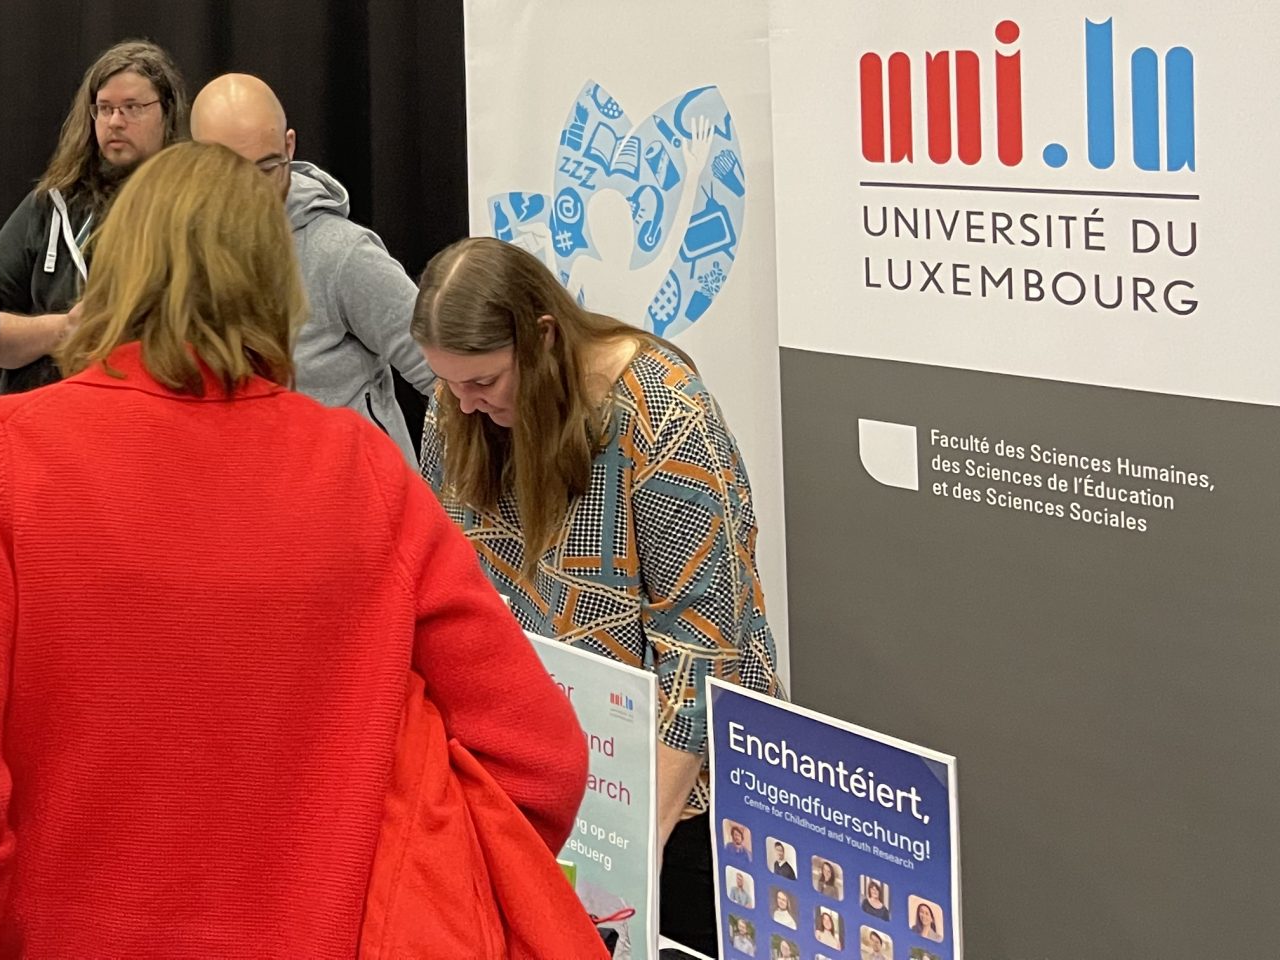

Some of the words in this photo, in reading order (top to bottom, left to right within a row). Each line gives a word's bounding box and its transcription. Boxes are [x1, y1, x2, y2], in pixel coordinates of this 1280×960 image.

[860, 16, 1196, 172] uni.lu
[863, 205, 1106, 252] UNIVERSITÉ
[1132, 219, 1197, 257] DU
[864, 257, 1199, 316] LUXEMBOURG
[930, 428, 990, 454] Faculté
[995, 439, 1025, 460] des
[1030, 444, 1112, 473] Sciences
[1117, 457, 1215, 492] Humaines,
[931, 454, 960, 474] des
[965, 459, 1043, 488] Sciences
[1047, 473, 1068, 493] de
[932, 481, 949, 497] et
[952, 482, 982, 503] des
[986, 488, 1065, 518] Sciences
[1070, 502, 1147, 532] Sociales
[582, 730, 615, 757] nd
[729, 721, 930, 825] Enchantéiert,
[566, 839, 612, 871] ebuerg
[590, 824, 606, 841] op
[608, 831, 631, 850] der
[744, 795, 770, 813] Centre
[771, 805, 783, 818] for
[784, 811, 826, 836] Childhood
[827, 829, 844, 843] and
[845, 834, 871, 853] Youth
[872, 845, 914, 870] Research
